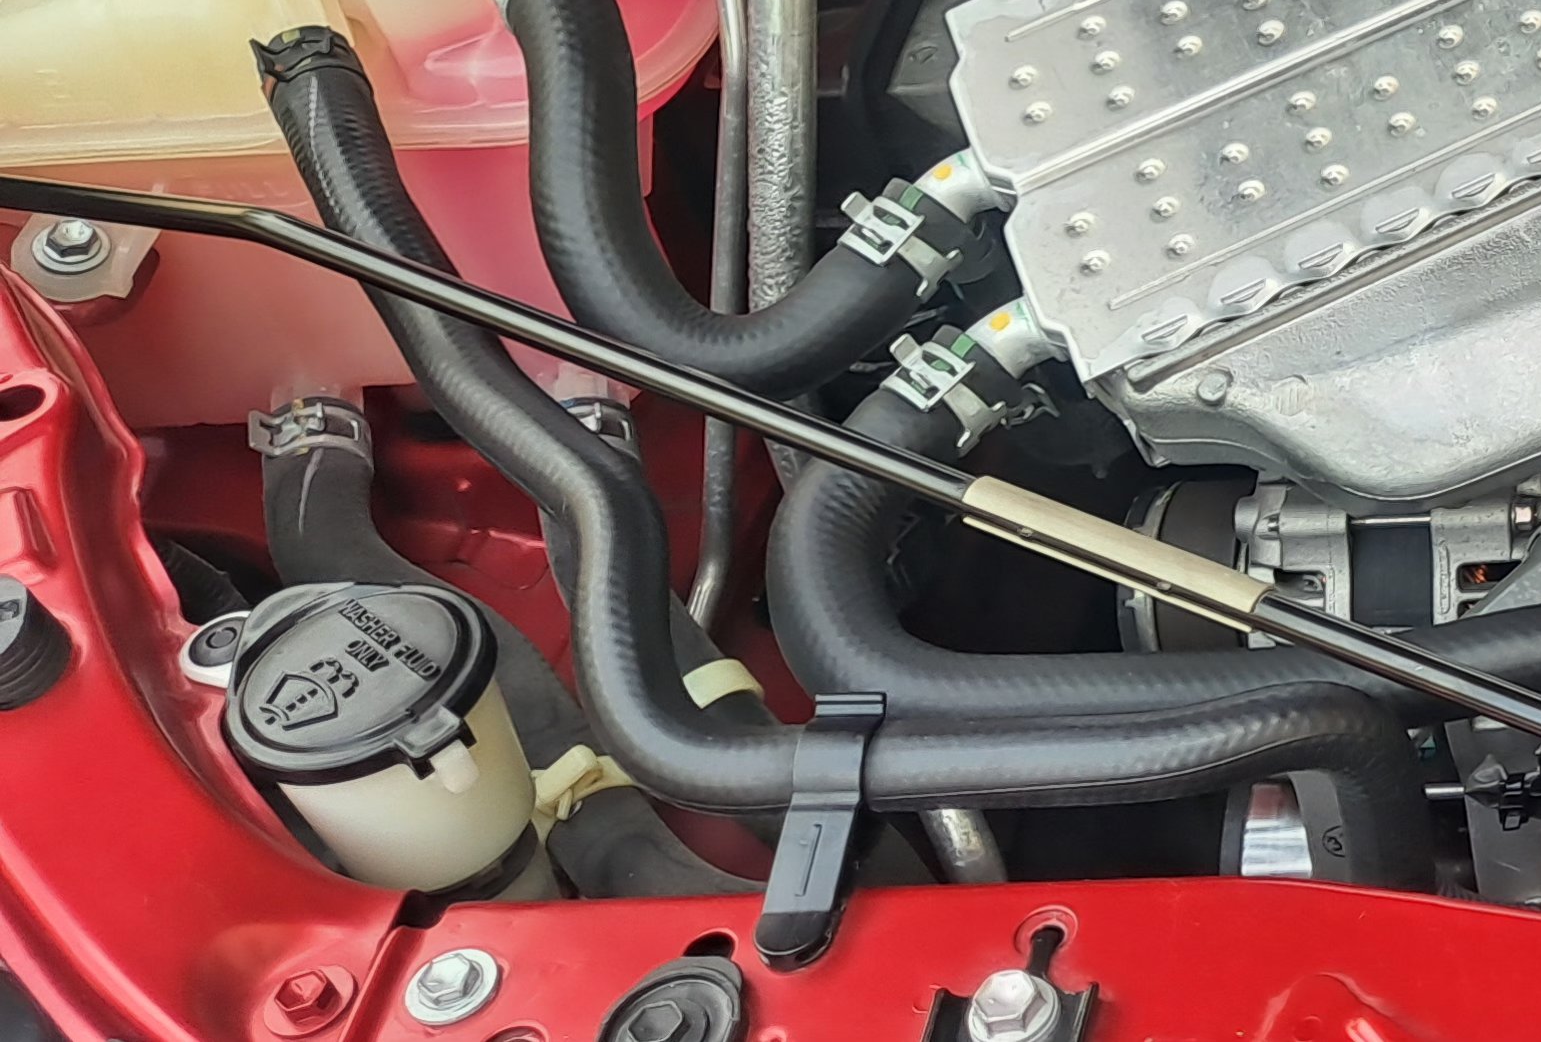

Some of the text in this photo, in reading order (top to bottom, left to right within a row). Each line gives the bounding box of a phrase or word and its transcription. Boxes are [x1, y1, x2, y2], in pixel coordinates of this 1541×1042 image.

[338, 598, 442, 682] WASHER FLUID
[345, 639, 390, 673] ONLY
